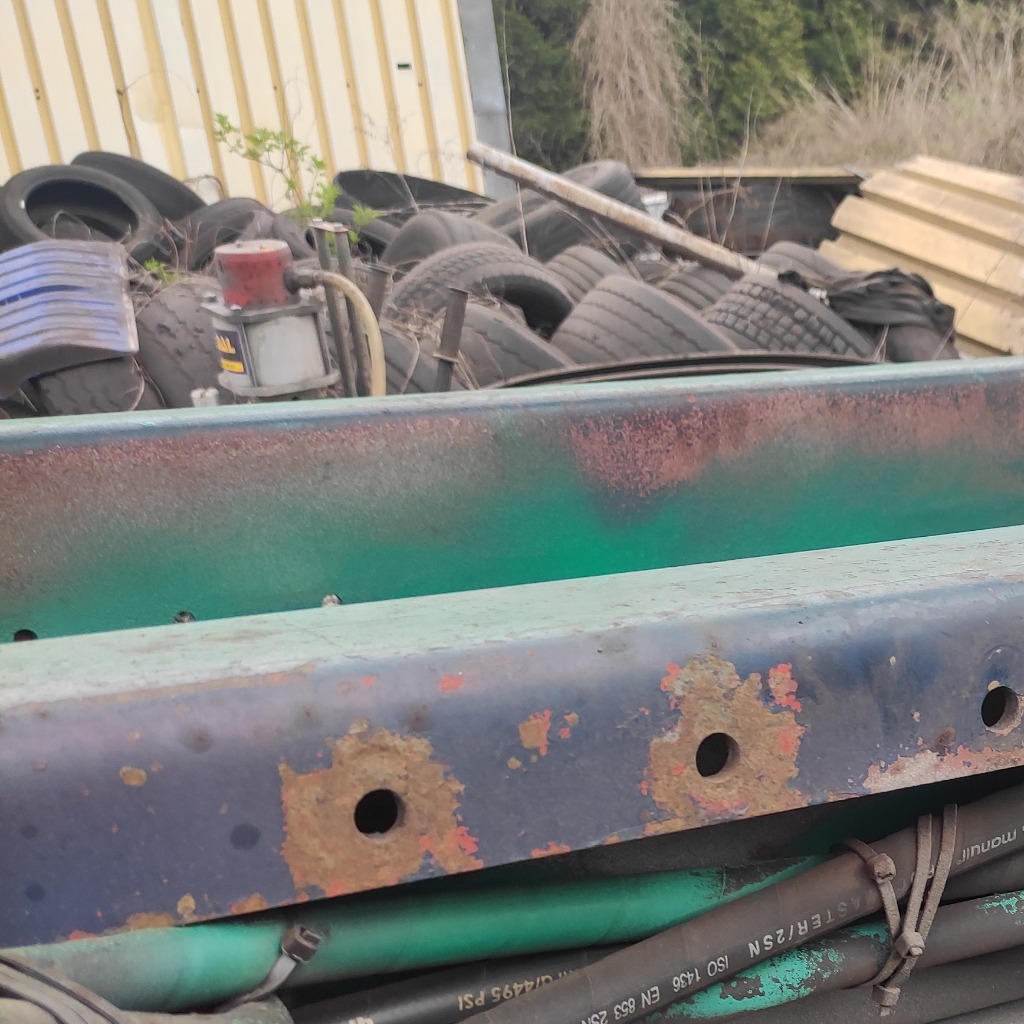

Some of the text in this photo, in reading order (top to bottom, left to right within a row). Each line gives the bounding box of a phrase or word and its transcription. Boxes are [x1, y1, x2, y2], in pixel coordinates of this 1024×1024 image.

[707, 955, 729, 977] ISO
[672, 967, 702, 993] 1436
[456, 990, 486, 1012] PSI
[641, 984, 661, 1009] EN
[614, 997, 636, 1021] 853
